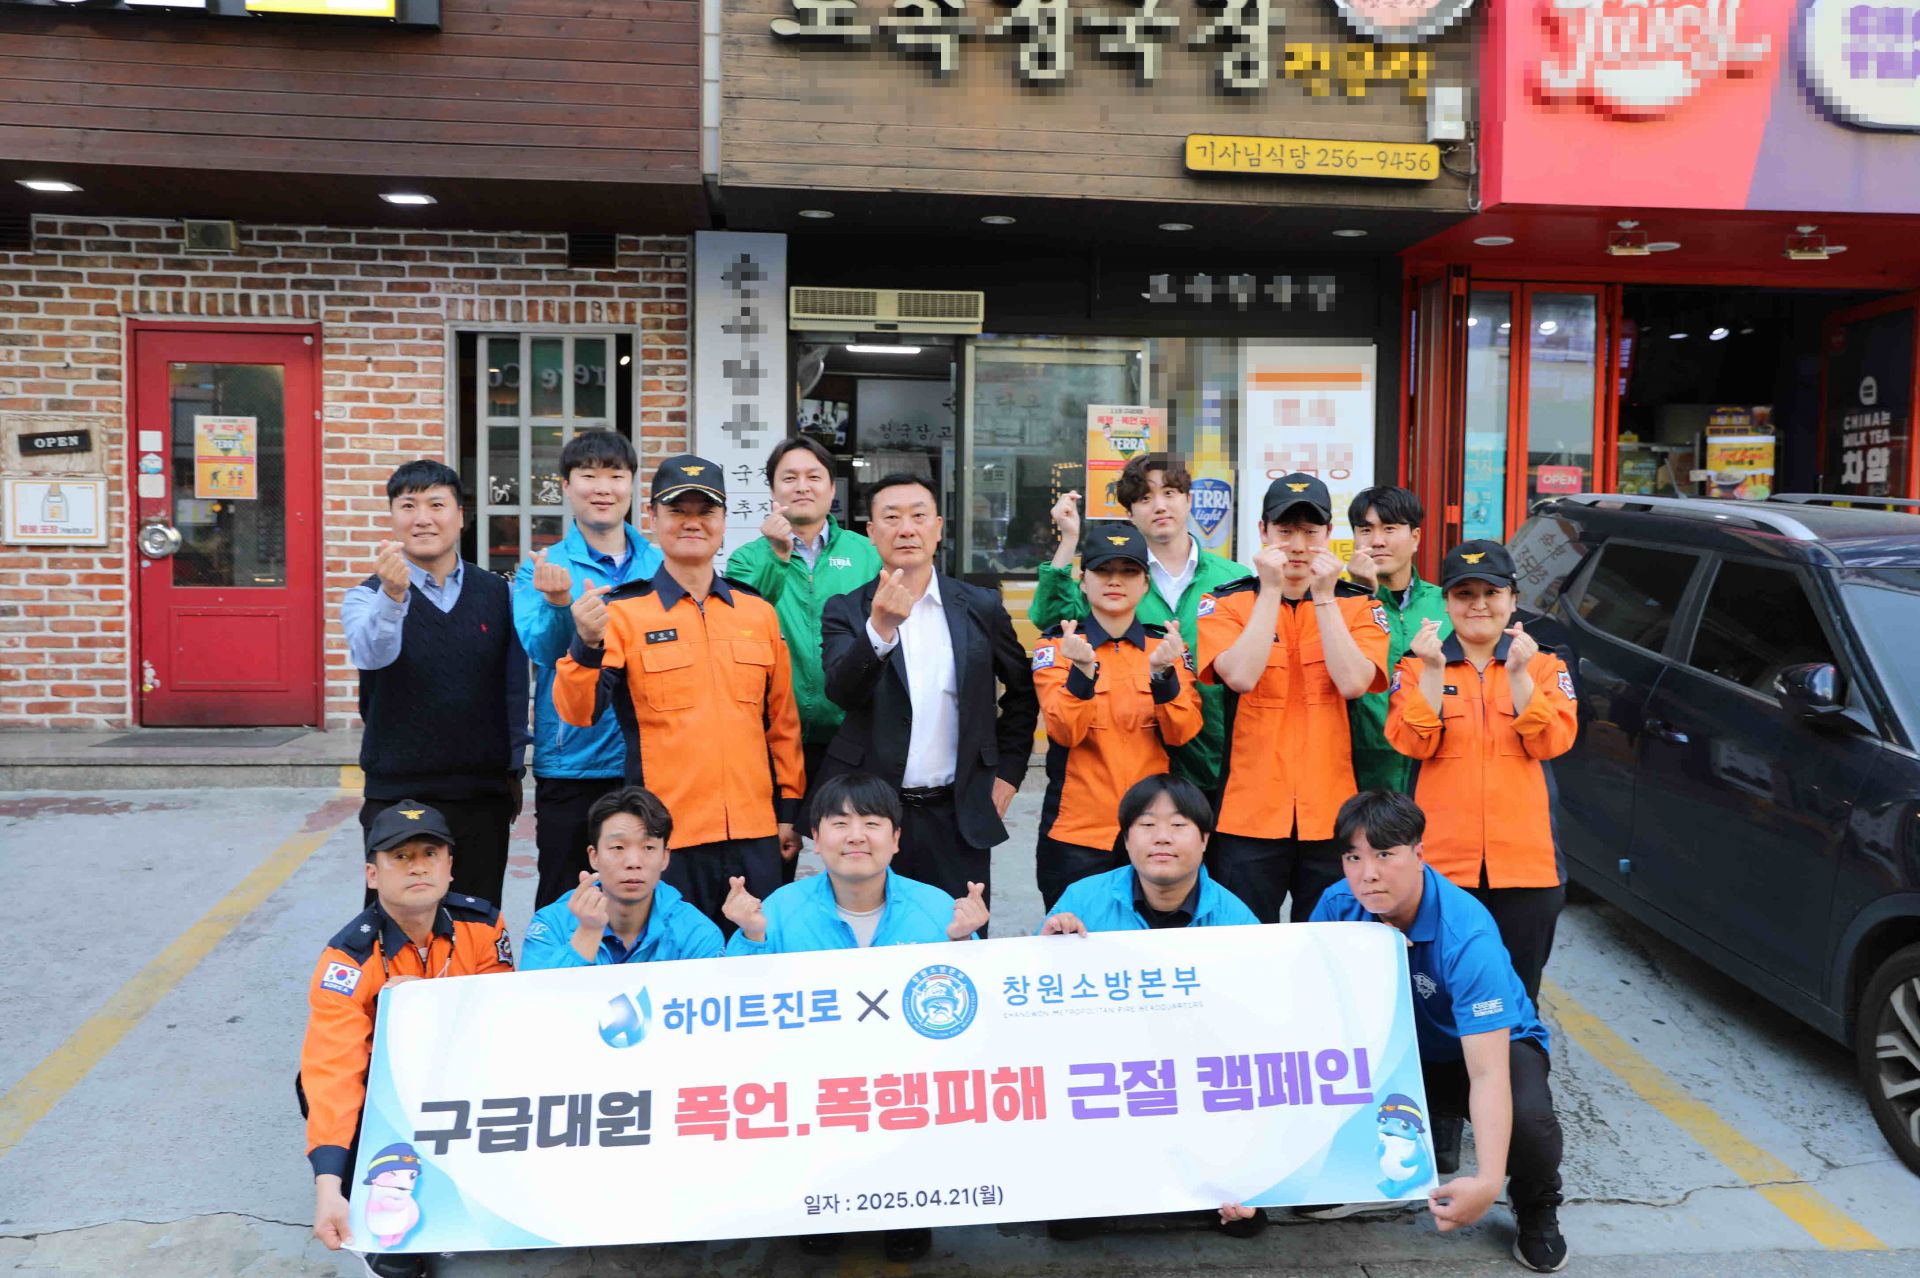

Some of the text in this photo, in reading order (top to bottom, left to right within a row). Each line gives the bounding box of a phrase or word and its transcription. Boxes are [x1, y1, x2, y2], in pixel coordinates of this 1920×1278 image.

[1196, 141, 1431, 172] 기사님식당 256-9456
[34, 435, 79, 448] OPEN
[1109, 437, 1146, 450] TERRA
[1869, 429, 1891, 444] TEA
[1542, 474, 1577, 485] OPEN
[1191, 489, 1231, 509] TERRA
[1003, 966, 1201, 1006] 창원소방본부
[662, 989, 842, 1034] 하이트진로
[414, 1047, 1374, 1155] 구급대원 폭언.폭행피해 근절 캠페인
[857, 1184, 1003, 1211] 2025.04.21(월)
